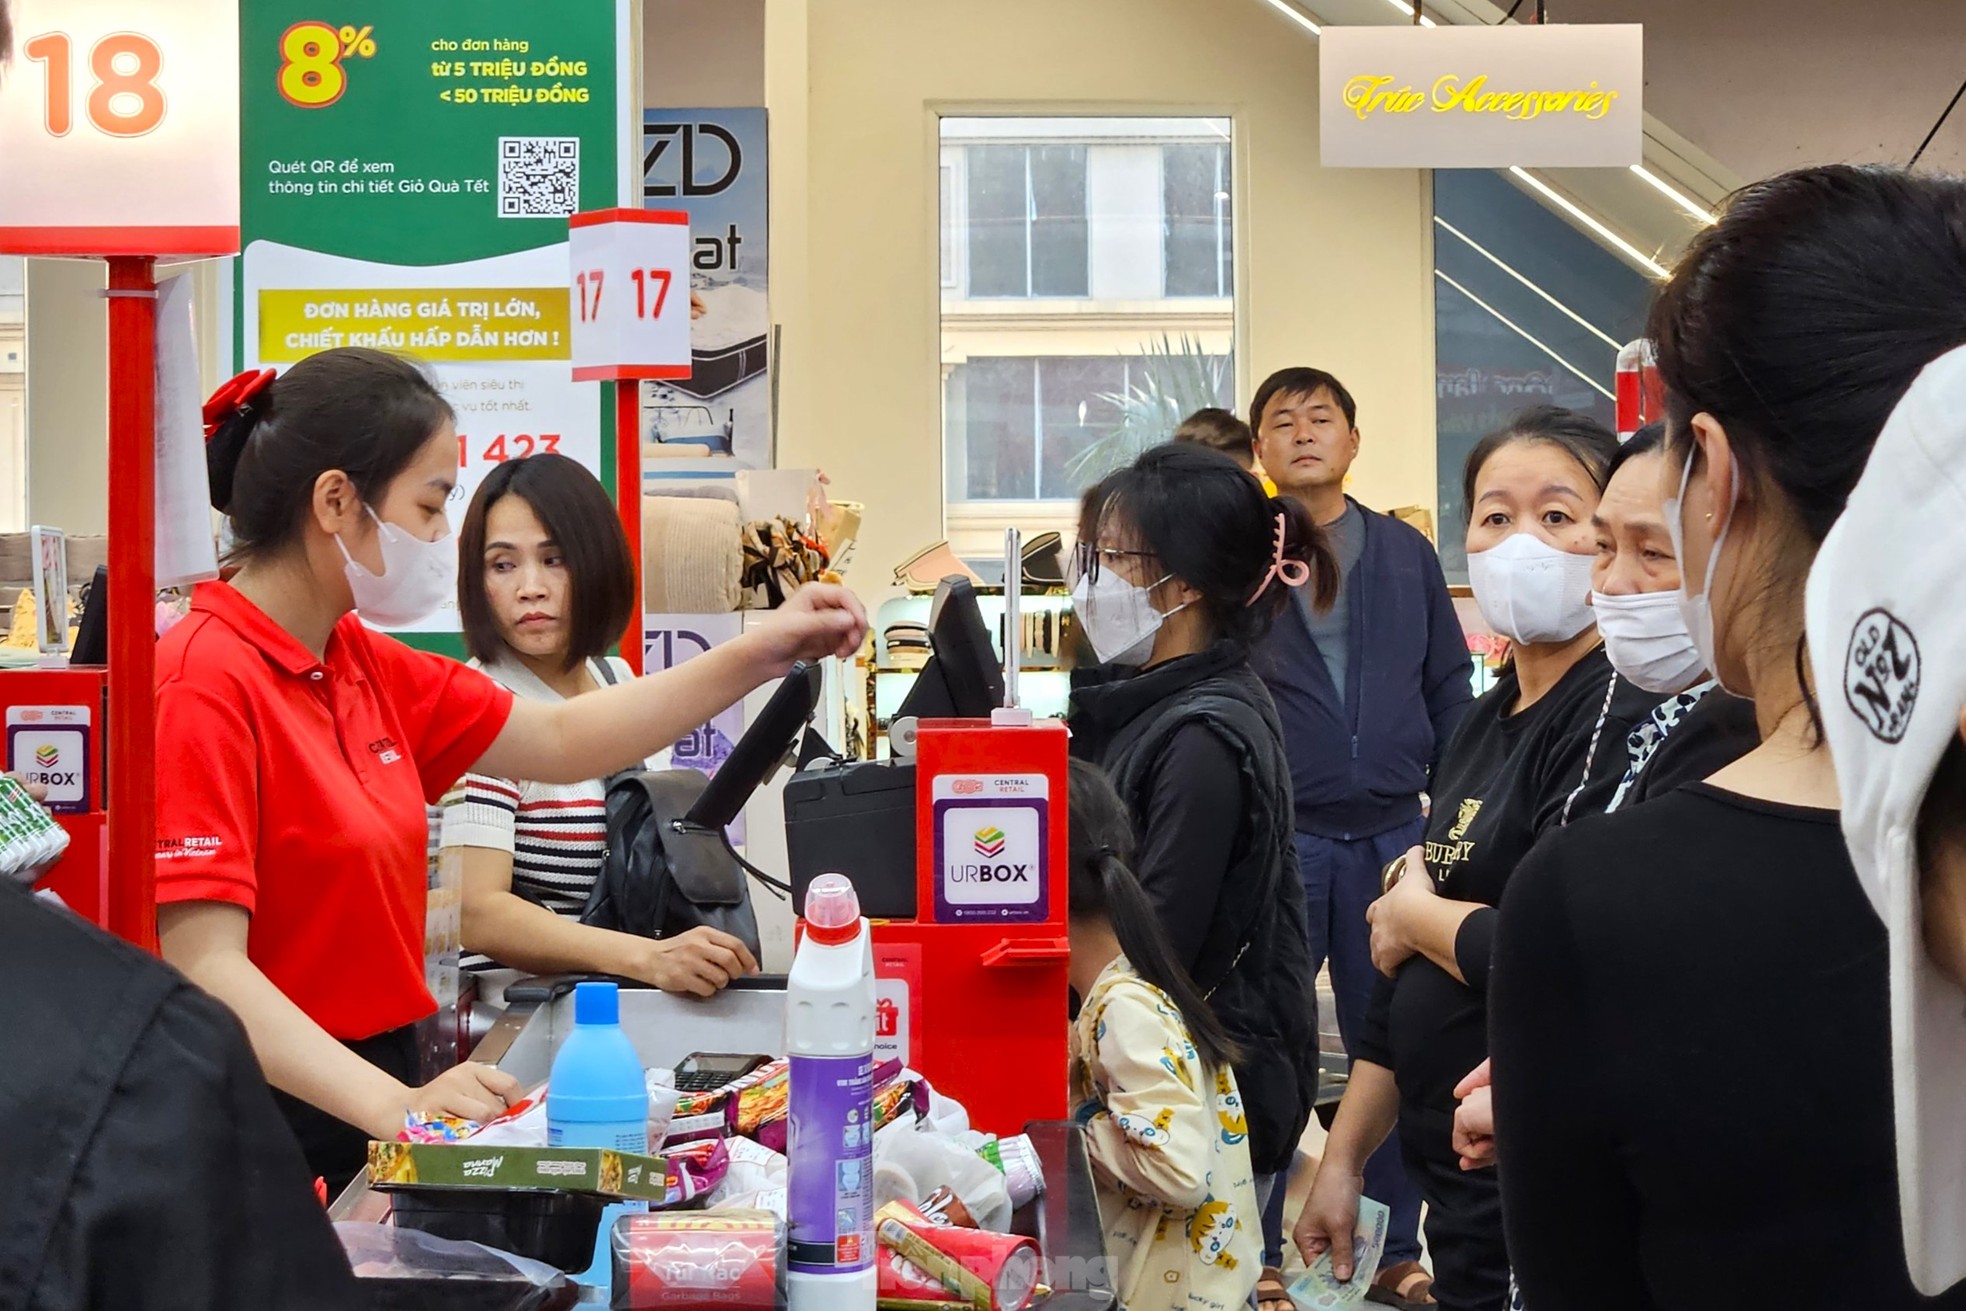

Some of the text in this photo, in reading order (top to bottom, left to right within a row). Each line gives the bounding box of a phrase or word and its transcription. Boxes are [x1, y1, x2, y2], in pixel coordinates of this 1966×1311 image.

[431, 37, 529, 55] cho đơn hàng
[278, 20, 377, 109] 8%
[431, 55, 588, 81] từ 5 TRIỆU ĐỒNG
[23, 29, 167, 138] 18
[454, 88, 478, 104] 50
[481, 87, 533, 106] TRIỆU
[535, 82, 589, 104] ĐỒNG
[1343, 74, 1619, 120] Trúc Accessories
[268, 158, 394, 176] Quét QR để xem
[268, 178, 489, 196] thông tin chi tiết Giỏ Quà Tết
[577, 269, 604, 323] 17
[631, 268, 672, 320] 17
[304, 298, 541, 321] ĐƠN HÀNG GIÁ TRỊ LỚN,
[285, 324, 560, 348] CHIẾT KHẤU HẤP DẪN HƠN !
